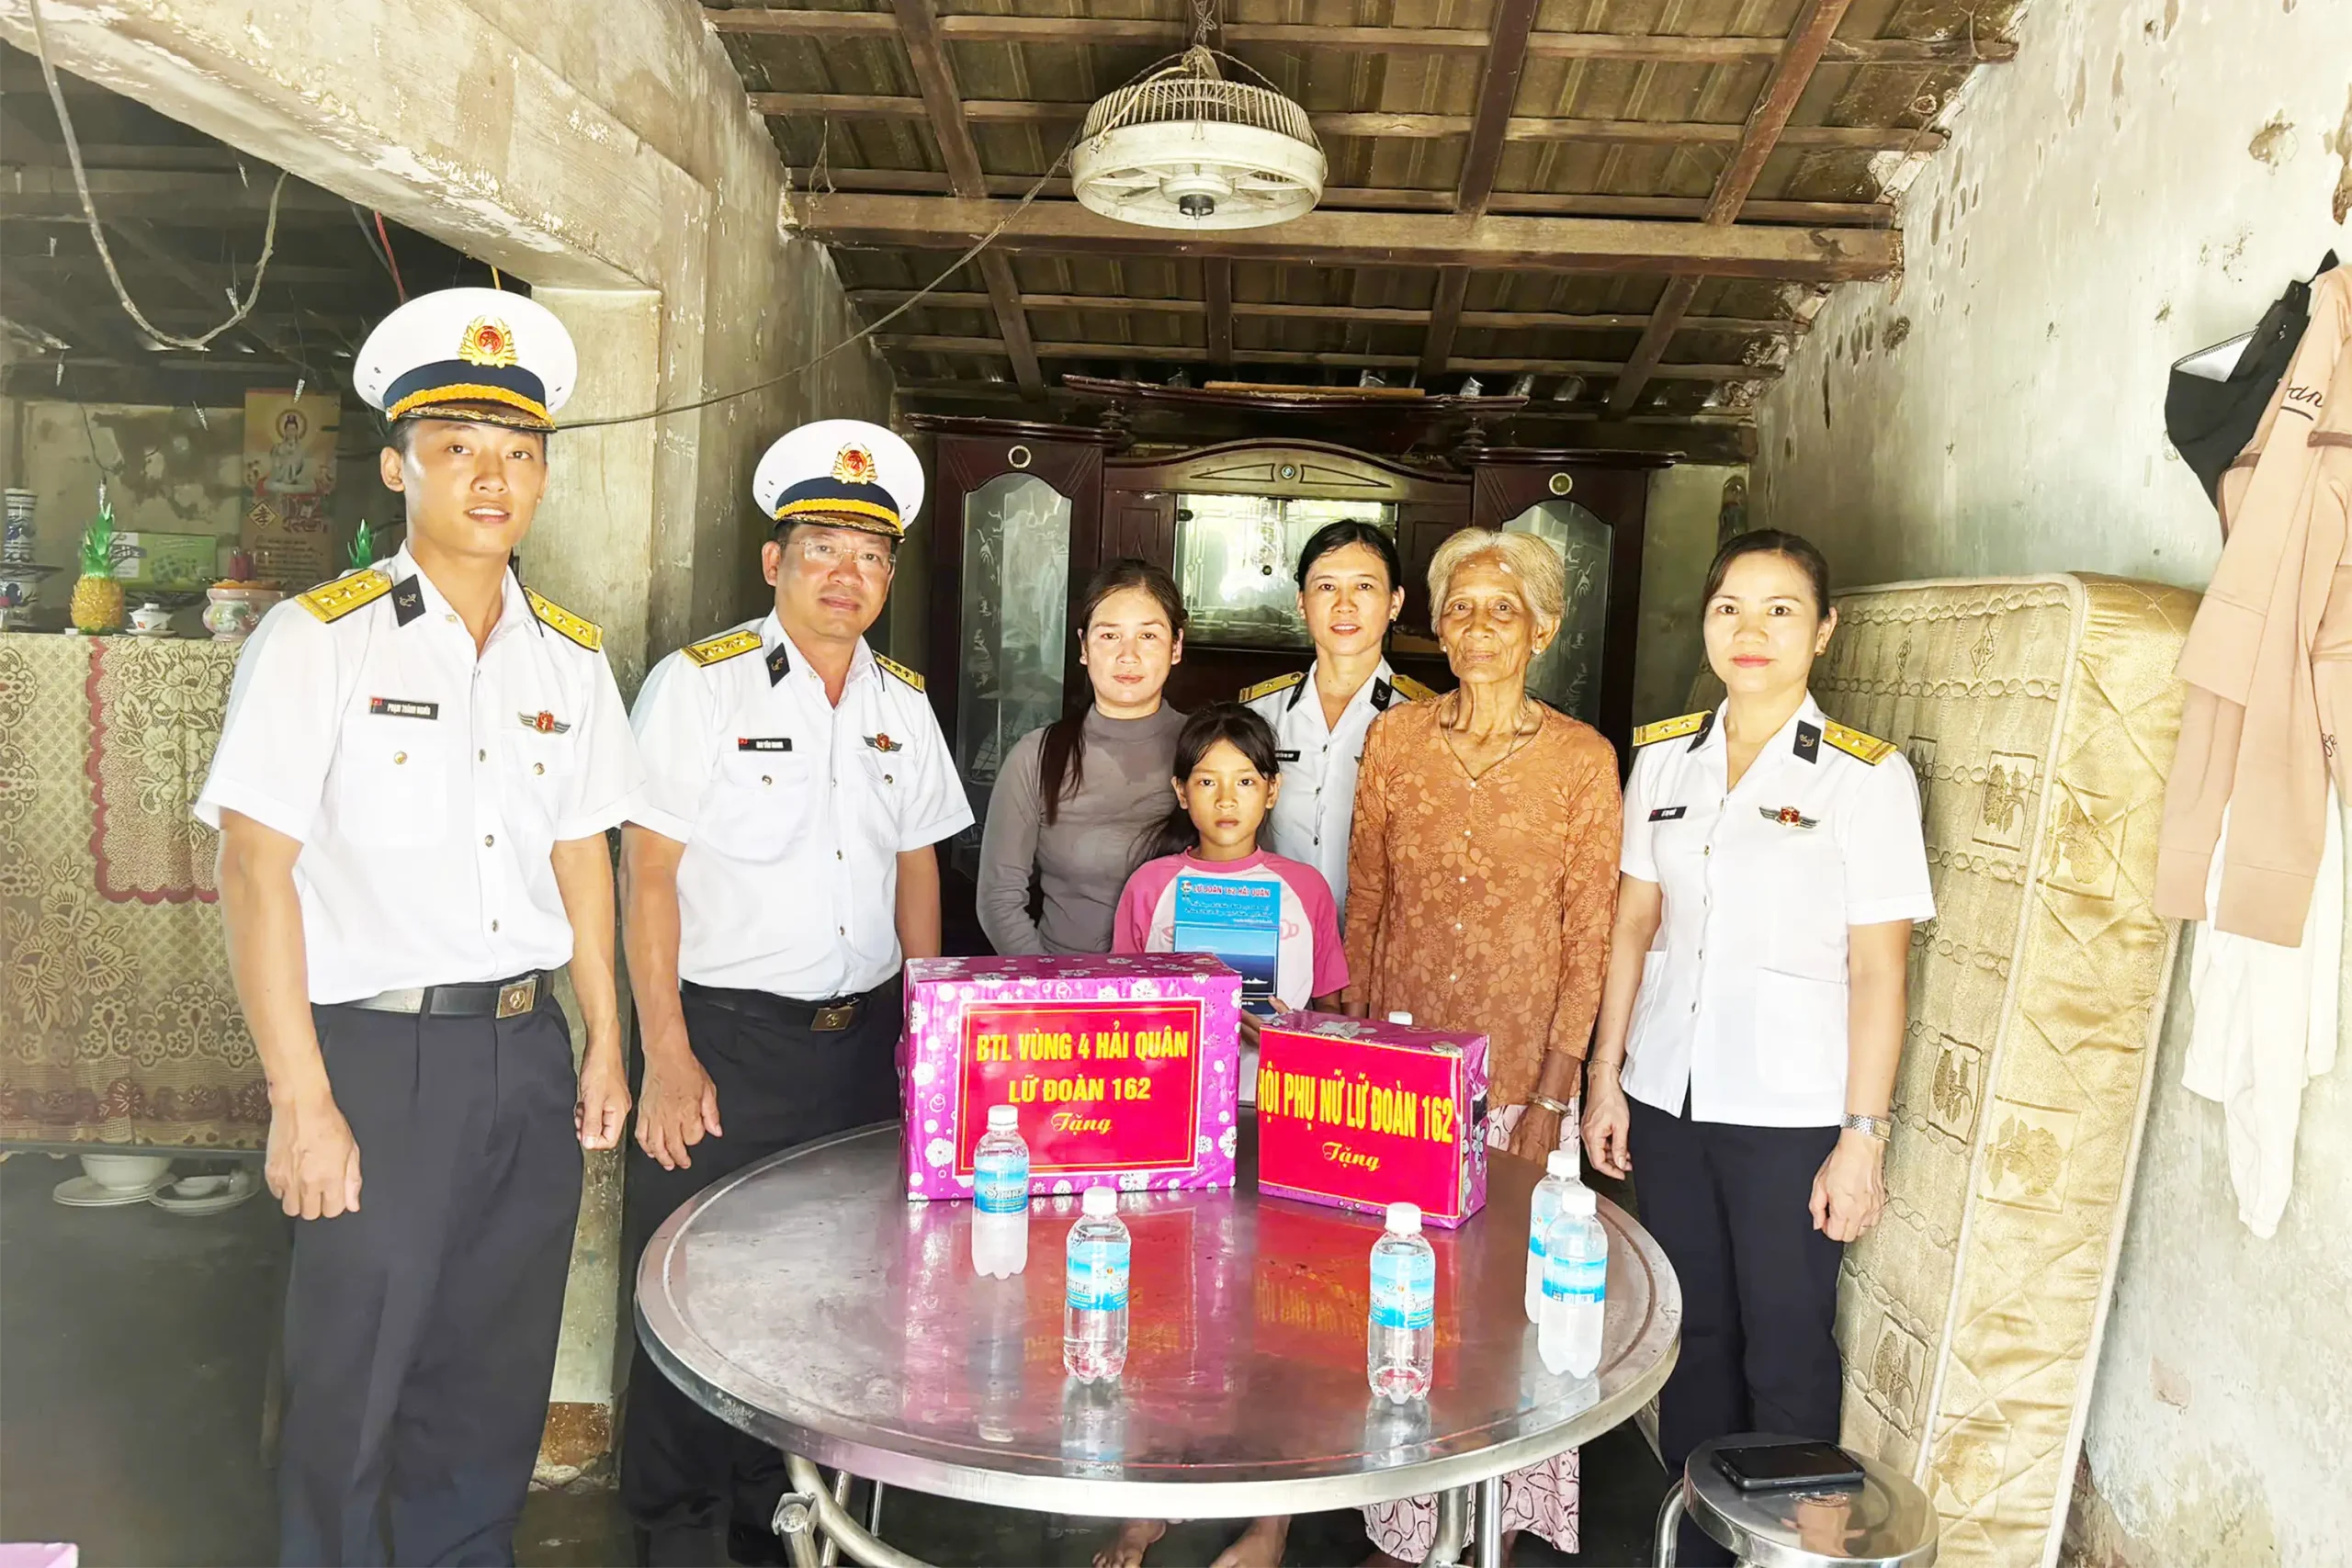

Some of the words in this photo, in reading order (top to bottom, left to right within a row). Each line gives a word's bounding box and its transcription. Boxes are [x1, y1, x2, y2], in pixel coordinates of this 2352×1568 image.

[976, 1033, 1012, 1062] BTL
[1018, 1027, 1072, 1062] VÙNG
[1078, 1032, 1091, 1060] 4
[1096, 1020, 1129, 1060] HẢI
[1135, 1025, 1189, 1061] QUÂN
[1008, 1073, 1040, 1103] LỮ
[1042, 1073, 1105, 1102] ĐOÀN
[1112, 1076, 1152, 1100] 162
[1283, 1072, 1317, 1131] PHỤ
[1319, 1068, 1346, 1126] NỮ
[1346, 1072, 1370, 1130] LỮ
[1370, 1079, 1418, 1138] ĐOÀN
[1421, 1095, 1454, 1145] 162
[1050, 1111, 1114, 1135] Tặng
[1321, 1141, 1382, 1172] Tặng
